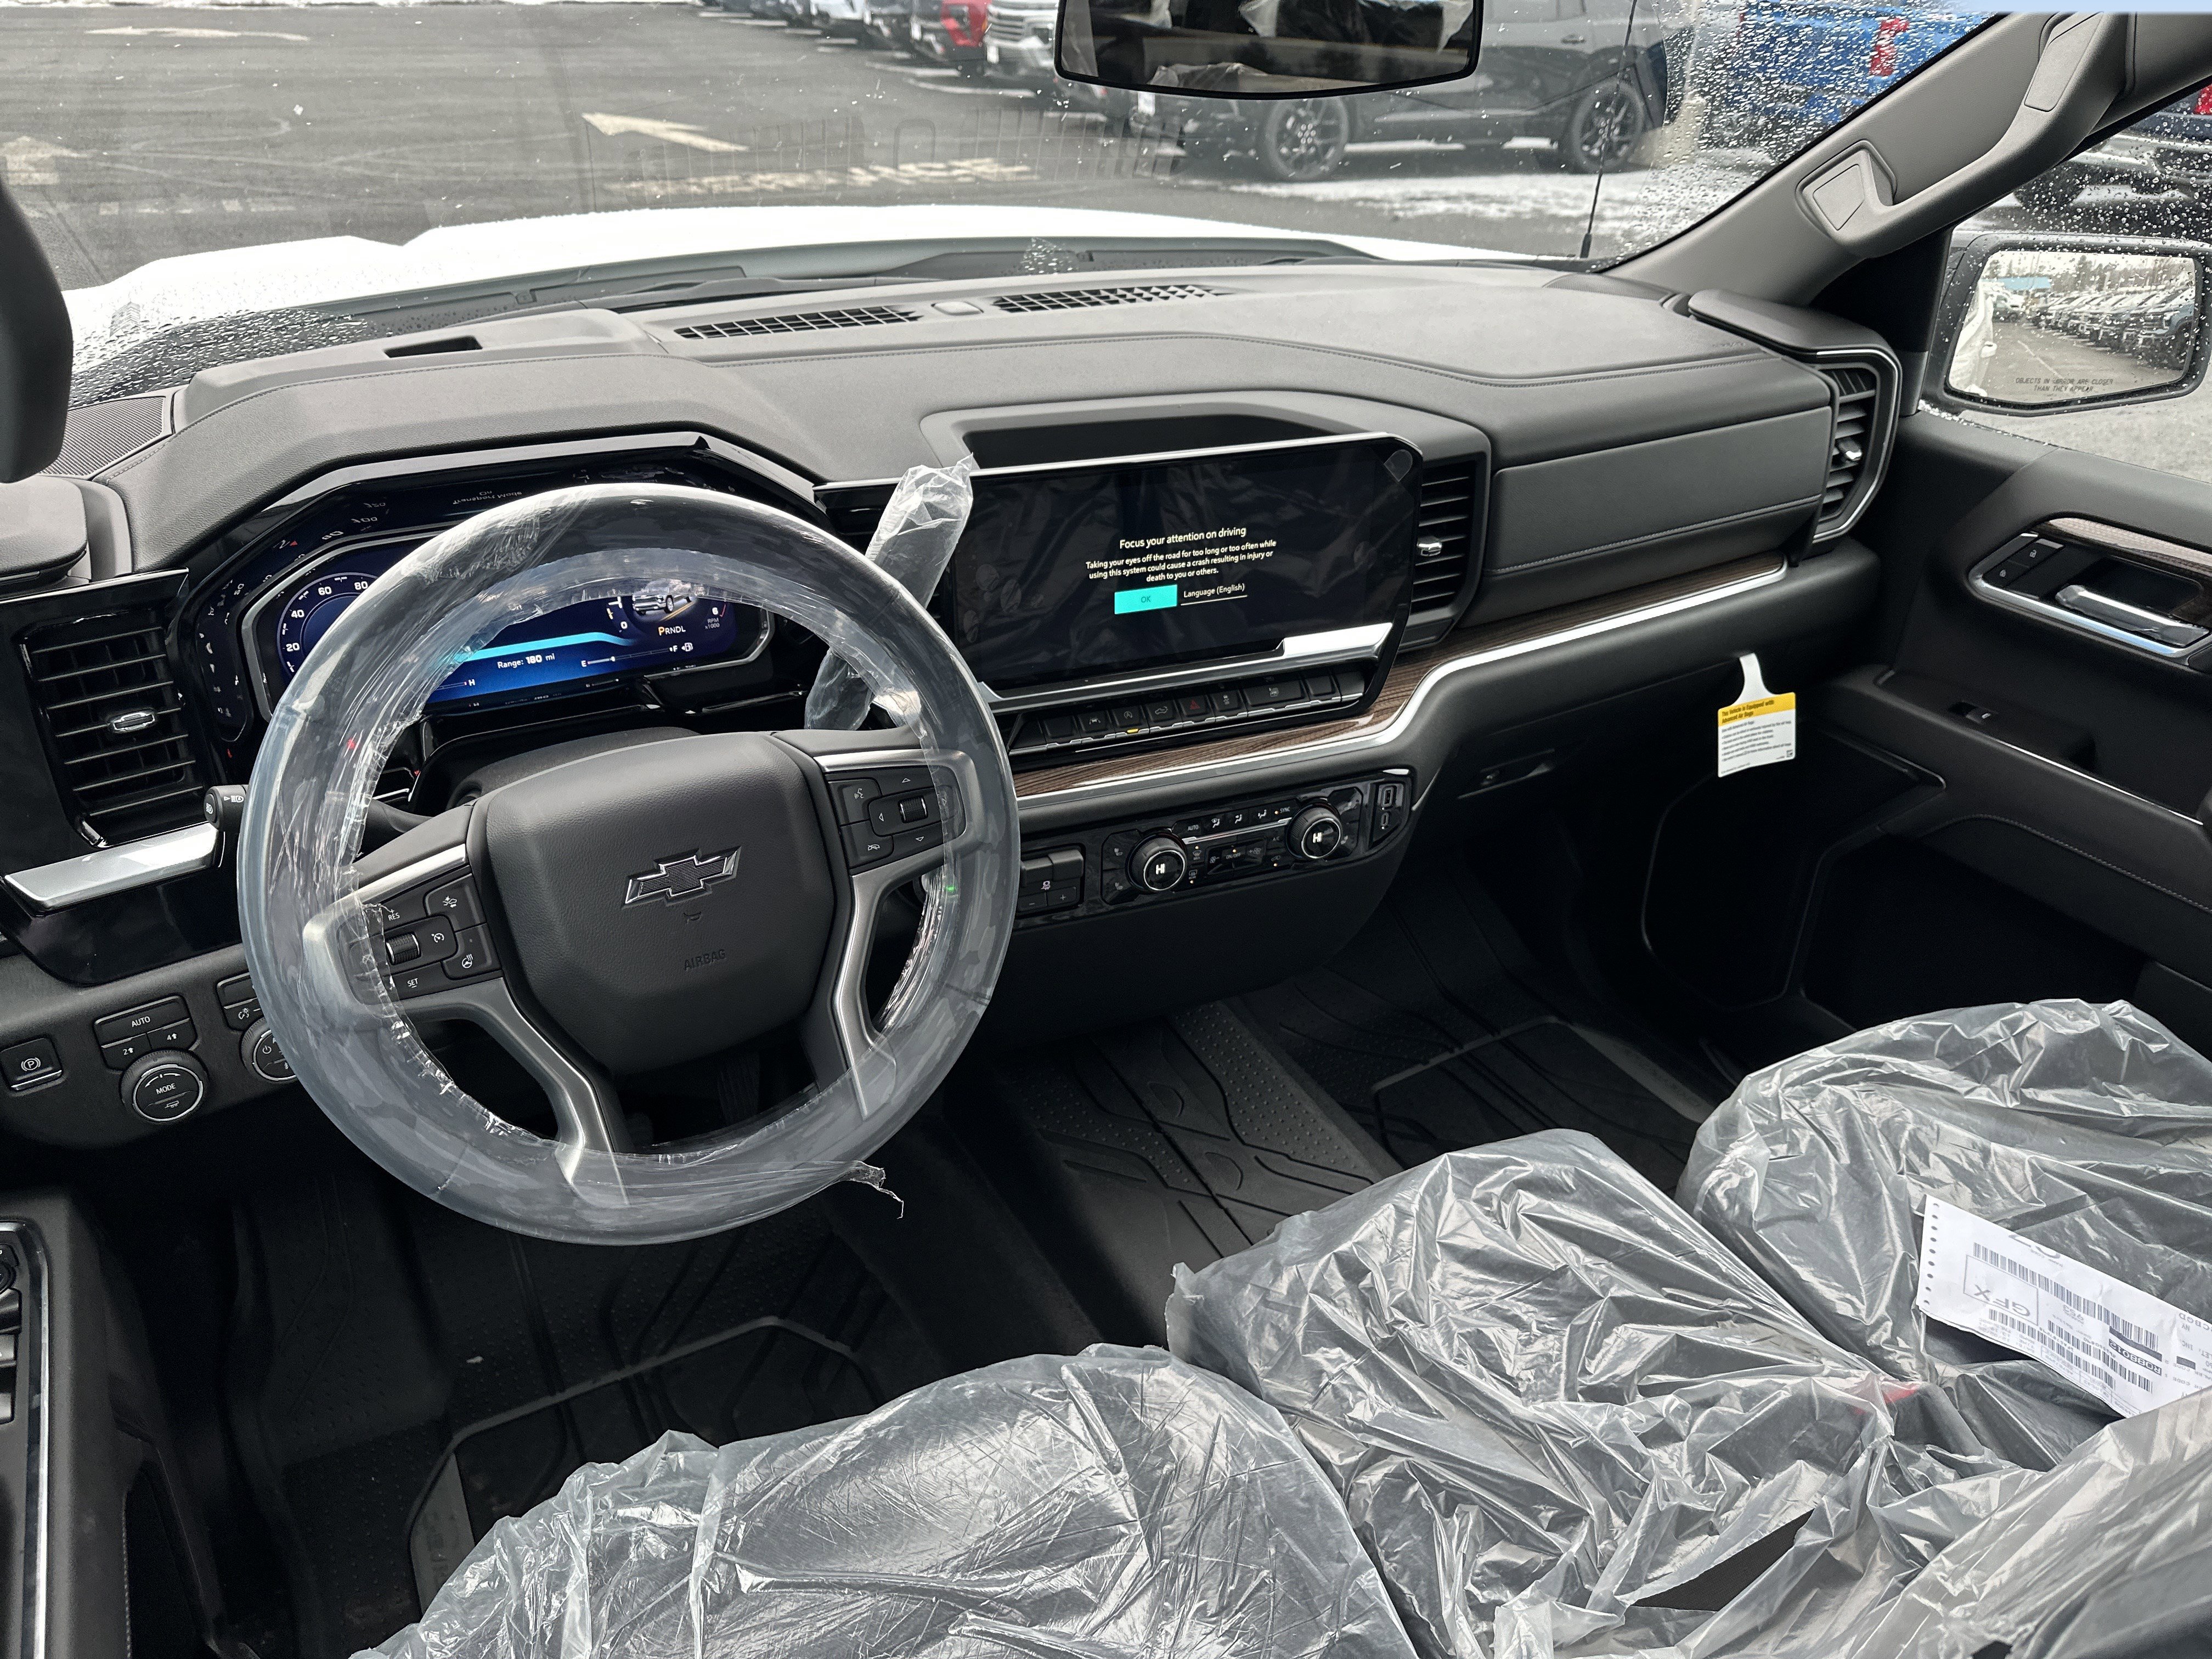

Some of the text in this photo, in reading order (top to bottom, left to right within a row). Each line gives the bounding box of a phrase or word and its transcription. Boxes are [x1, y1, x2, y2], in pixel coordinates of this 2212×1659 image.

[1120, 527, 1246, 549] Focus your attention on driving
[1086, 560, 1108, 569] Taking
[1109, 559, 1124, 568] your
[1125, 557, 1141, 566] eyes
[1142, 554, 1152, 562] off
[1165, 551, 1180, 559] road
[1181, 550, 1191, 558] for
[1241, 542, 1258, 550] often
[1260, 539, 1277, 548] while
[1089, 571, 1108, 579] using
[1122, 566, 1147, 576] system
[1148, 563, 1165, 572] could
[1192, 557, 1210, 567] crash
[1210, 554, 1238, 563] resulting
[1247, 552, 1265, 560] injury
[1146, 572, 1165, 582] death
[1175, 571, 1187, 580] you
[318, 586, 332, 595] 60
[354, 581, 368, 590] 80
[1183, 583, 1245, 598] Language (English)
[291, 610, 304, 618] 40
[286, 642, 300, 652] 20
[497, 659, 523, 668] Range:
[525, 654, 543, 664] 180
[388, 912, 400, 921] RES
[684, 949, 726, 971] AIRBAG
[407, 978, 419, 987] SET
[131, 1016, 151, 1028] AUTO
[156, 1083, 176, 1094] MODE
[1974, 1284, 2030, 1318] GFX
